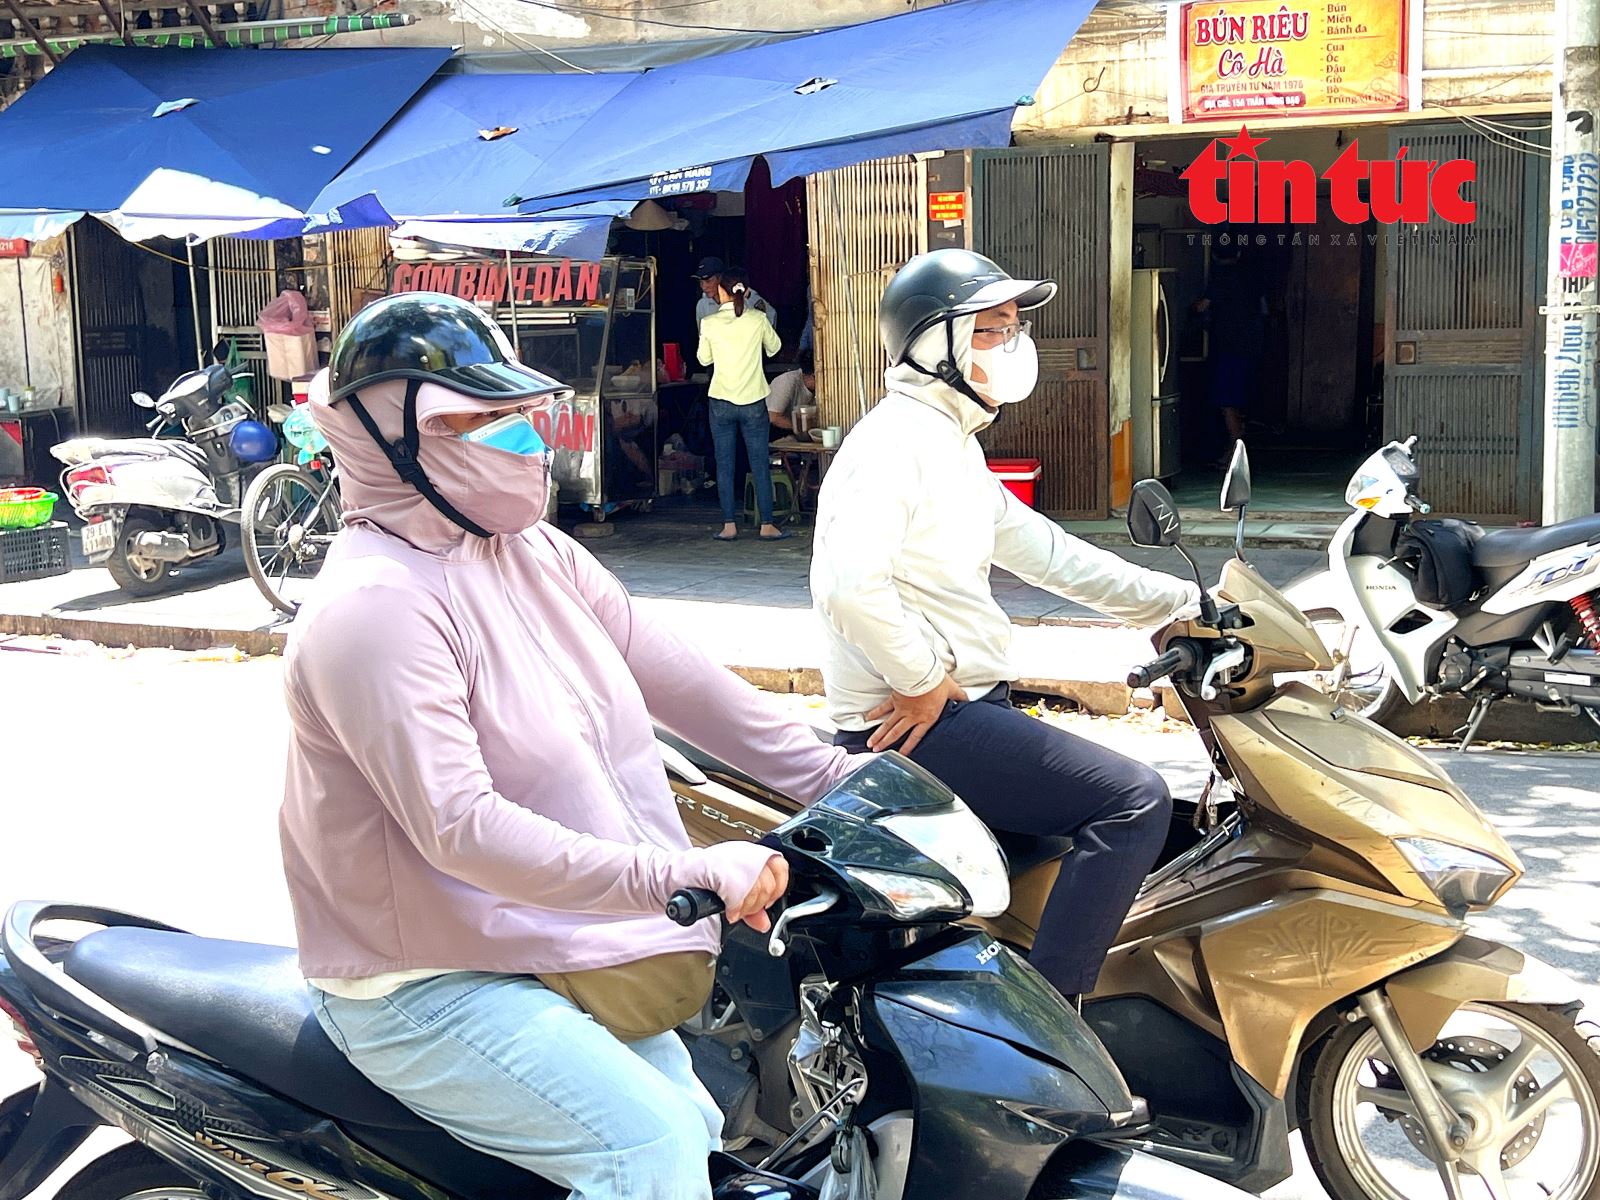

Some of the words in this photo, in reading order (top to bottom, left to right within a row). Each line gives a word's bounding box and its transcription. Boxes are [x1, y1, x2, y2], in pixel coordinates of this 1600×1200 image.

[1327, 3, 1347, 13] Bún
[1196, 9, 1246, 43] BÚN
[1251, 5, 1309, 40] RIÊU
[1327, 25, 1353, 35] Bánh
[1355, 24, 1368, 34] đa
[1218, 48, 1246, 77] Cô
[1248, 46, 1285, 77] Hà
[1326, 43, 1345, 52] Cua
[393, 261, 456, 295] CƠM
[533, 403, 595, 452] DÂN
